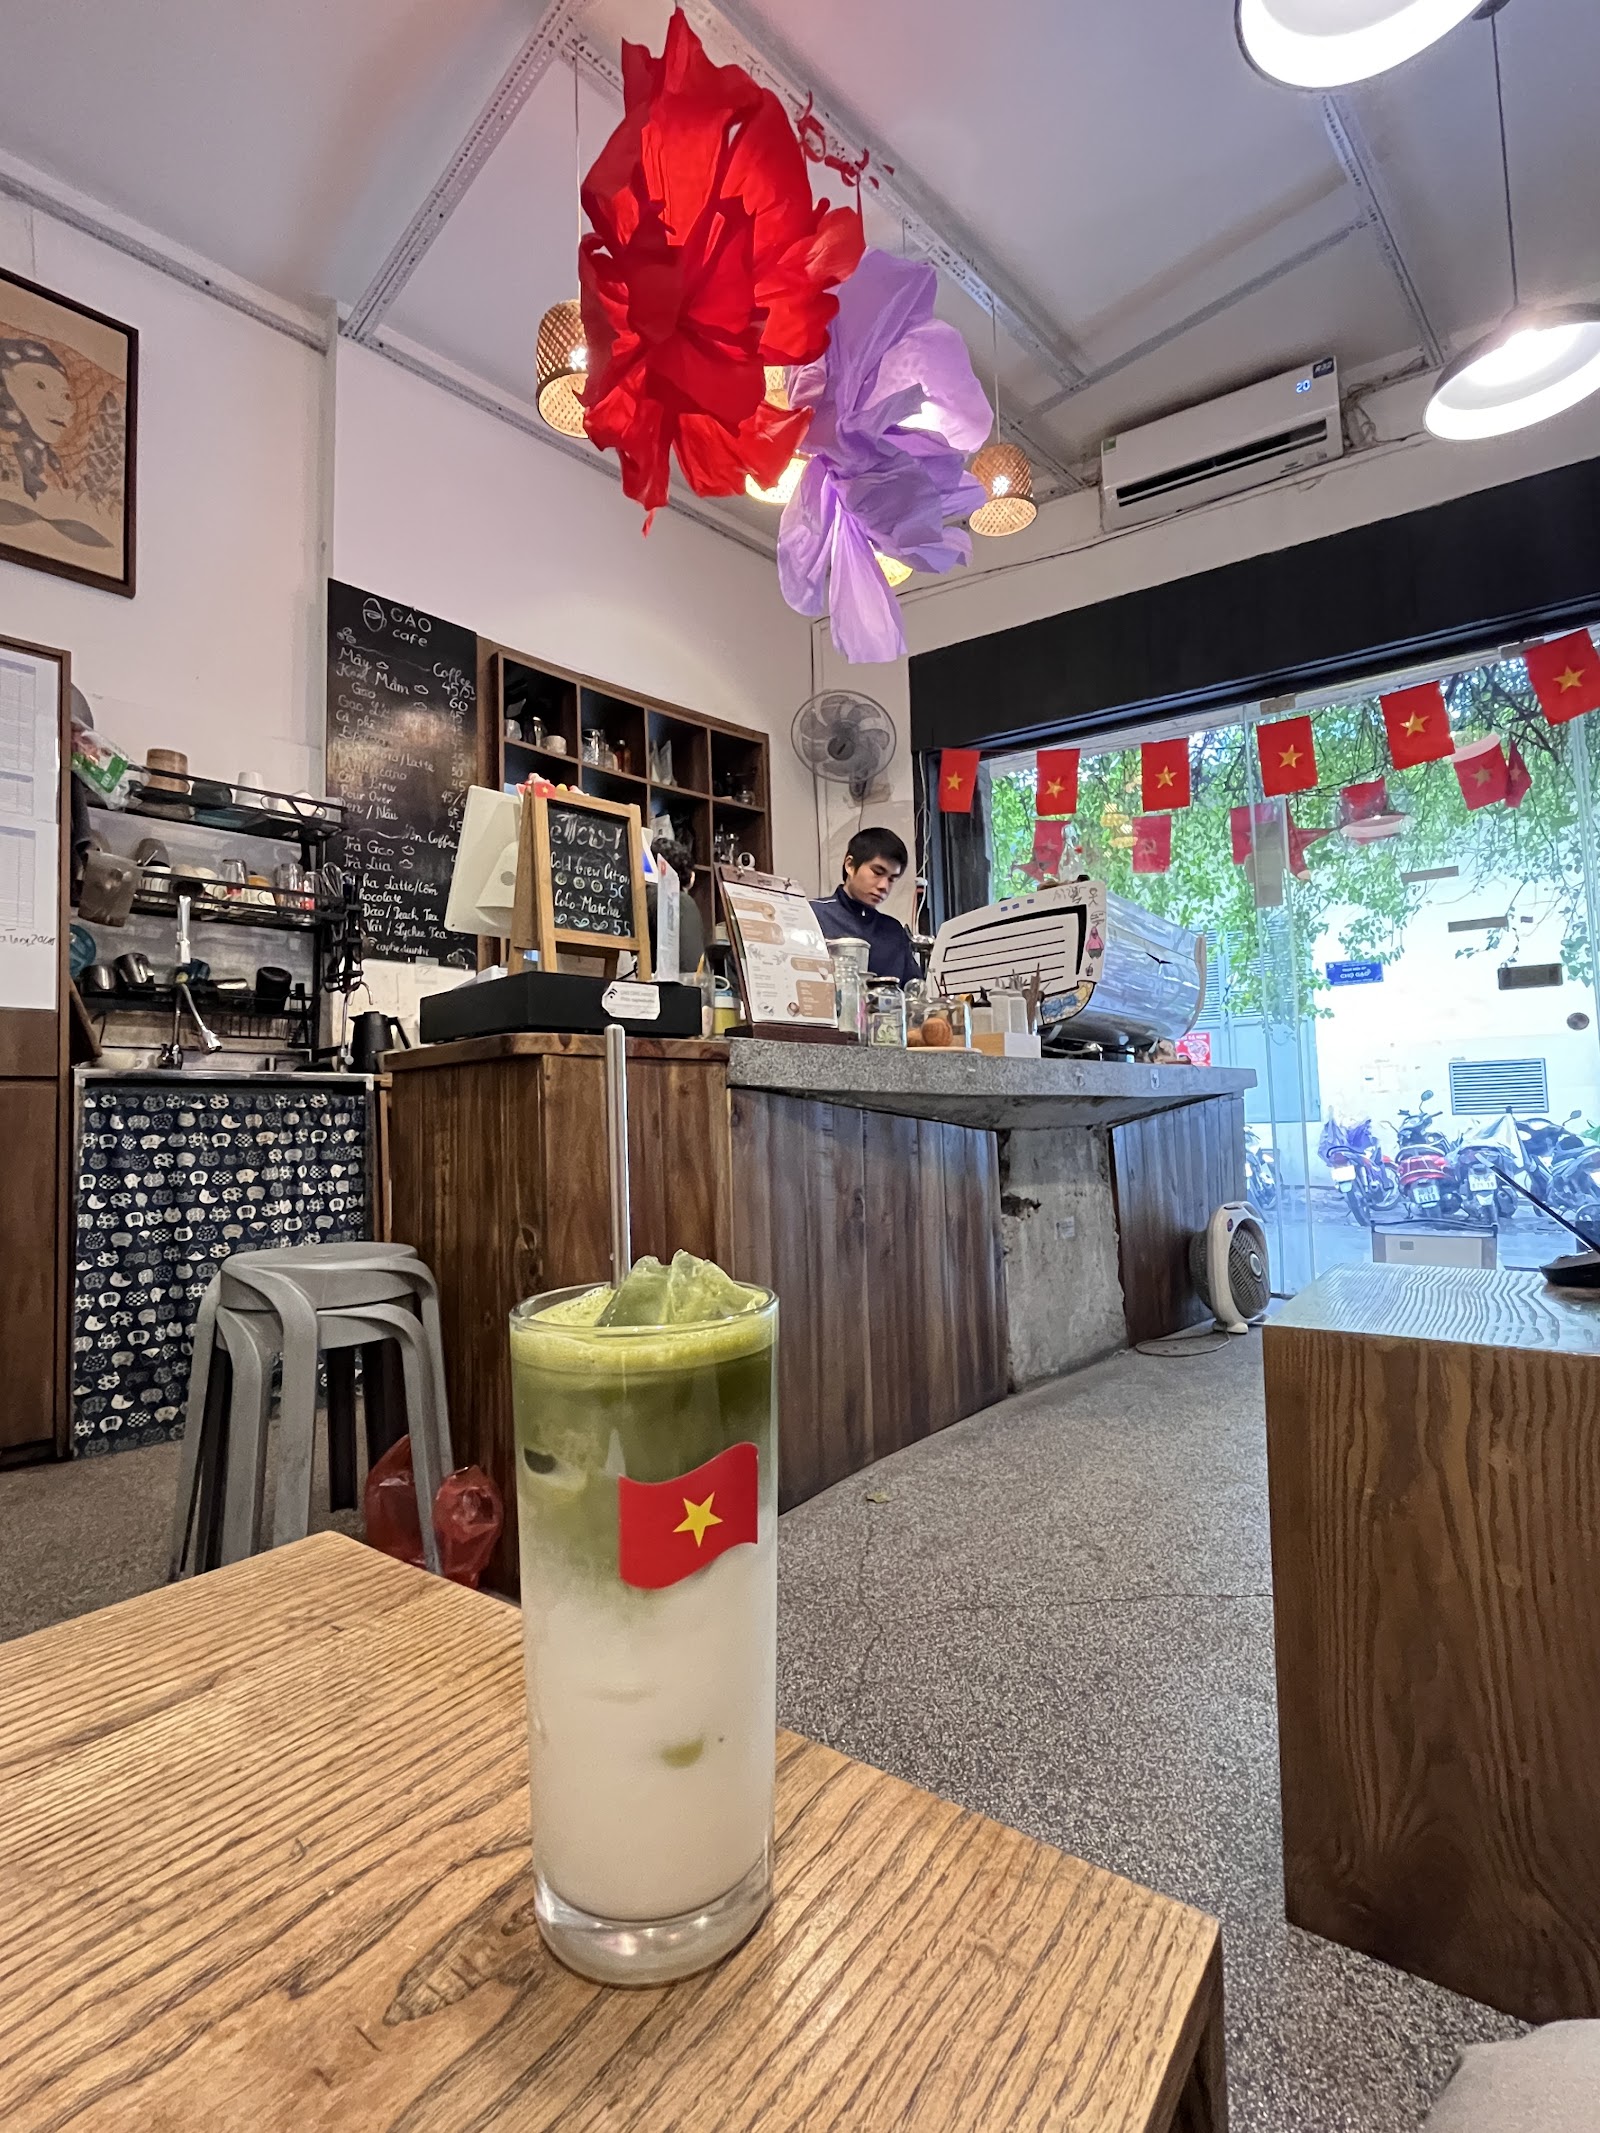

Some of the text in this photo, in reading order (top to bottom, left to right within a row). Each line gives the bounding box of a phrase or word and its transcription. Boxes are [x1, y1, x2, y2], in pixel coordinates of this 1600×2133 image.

[1296, 379, 1310, 393] 20
[392, 629, 428, 647] cafe
[338, 647, 372, 677] Mây
[449, 697, 469, 711] 60
[452, 779, 467, 793] 45
[369, 790, 392, 804] Over
[447, 806, 460, 819] 65
[343, 834, 362, 852] Trà
[343, 853, 362, 870] Trà
[550, 851, 572, 872] Cold
[359, 888, 403, 904] hocolate
[428, 926, 448, 940] Tea
[612, 919, 631, 937] 55
